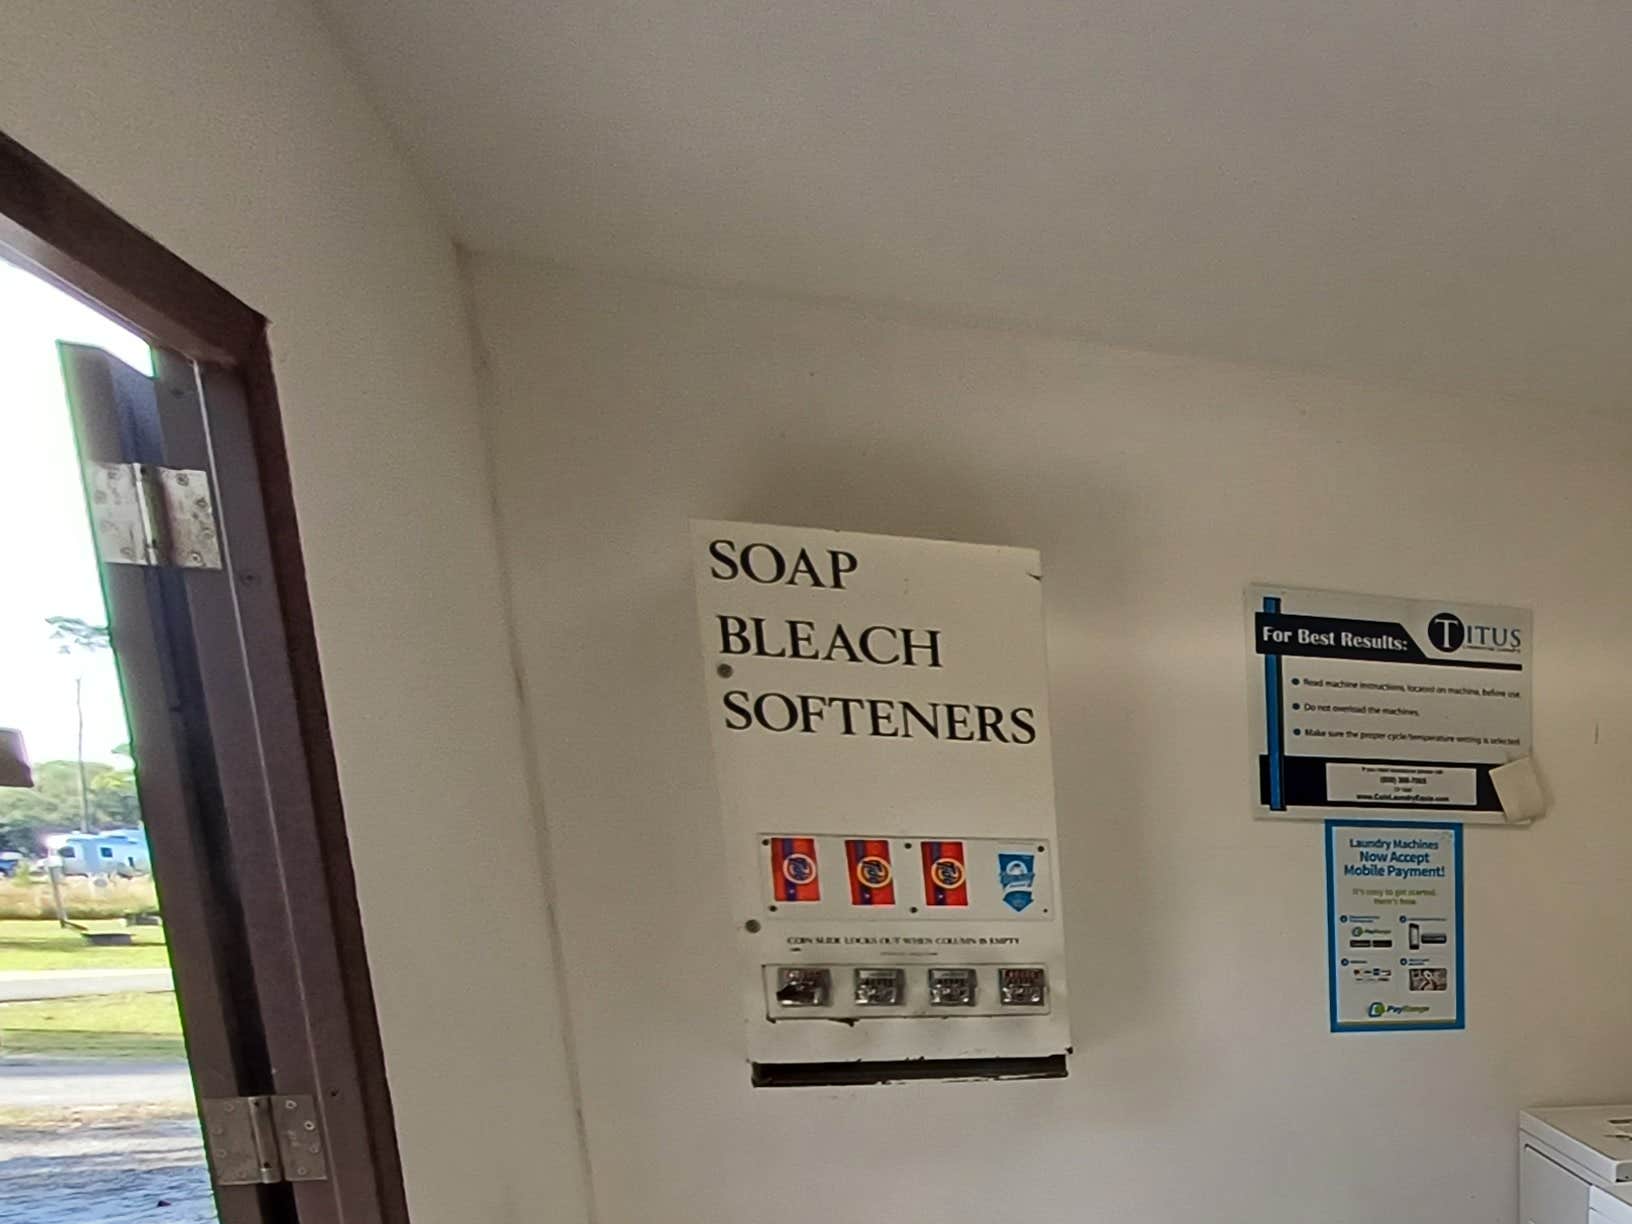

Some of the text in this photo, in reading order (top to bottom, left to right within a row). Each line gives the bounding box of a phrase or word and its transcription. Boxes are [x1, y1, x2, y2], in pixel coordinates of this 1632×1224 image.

[709, 540, 857, 589] SOAP
[1263, 626, 1408, 651] For Best Results:
[1434, 617, 1521, 648] TITUS
[716, 615, 942, 667] BLEACH
[1325, 680, 1358, 688] machine
[1436, 686, 1447, 694] on
[1483, 688, 1506, 697] before
[1304, 703, 1316, 712] Do
[1332, 705, 1366, 714] overload
[1368, 706, 1380, 714] the
[723, 690, 1036, 744] SOFTENERS
[1305, 728, 1326, 737] Make
[1346, 730, 1358, 738] the
[1360, 732, 1385, 741] proper
[1350, 838, 1439, 851] Laundry Machines
[1360, 851, 1430, 866] Now Accept
[1344, 864, 1445, 880] Mobile Payment!
[990, 937, 1020, 945] EMPTY
